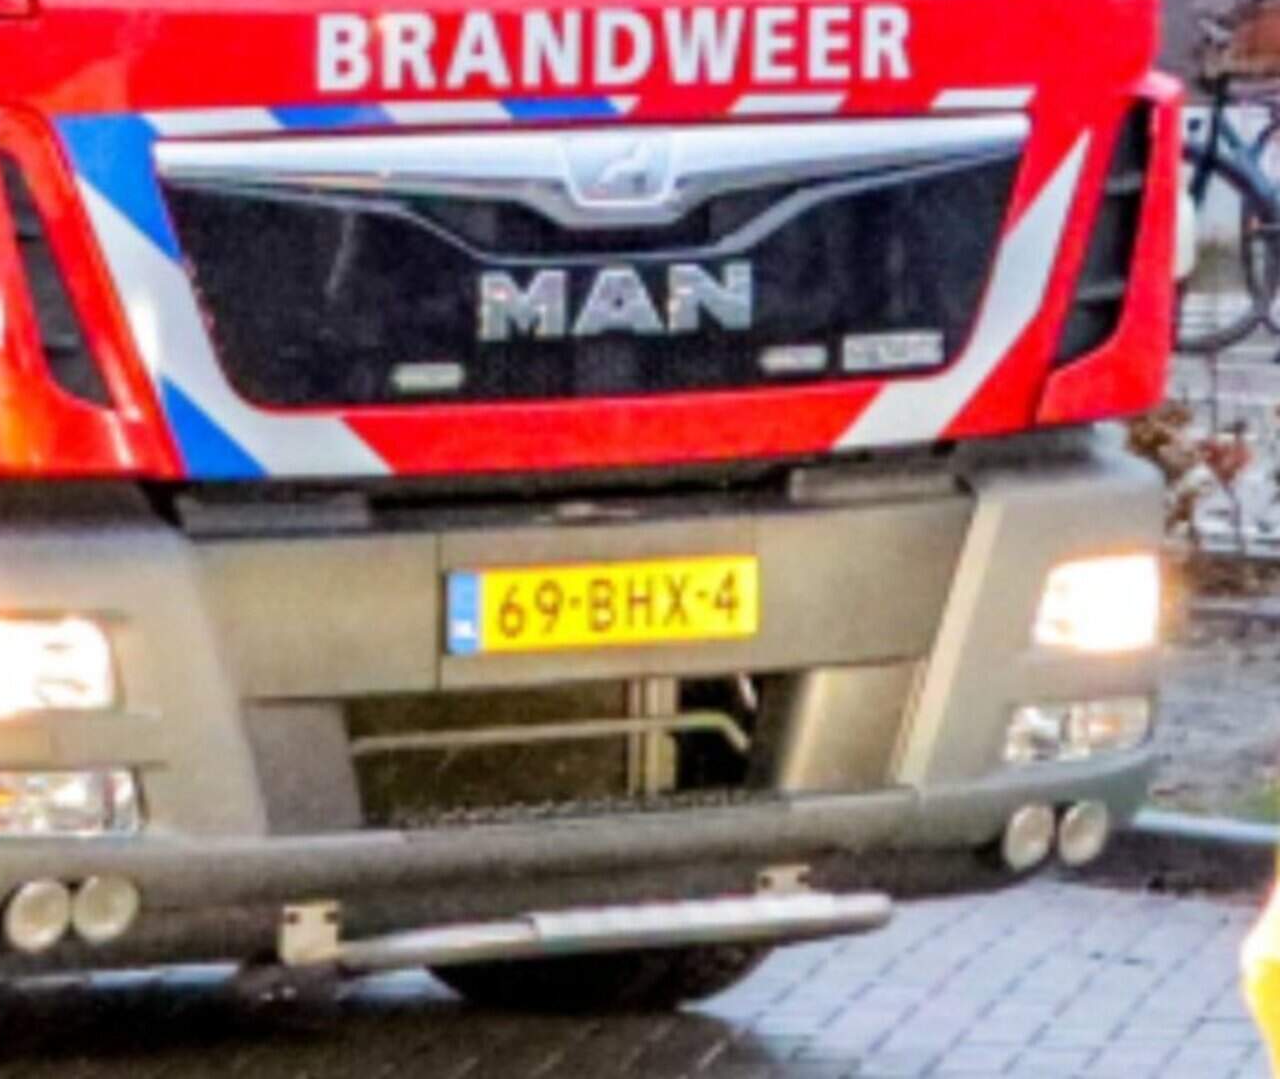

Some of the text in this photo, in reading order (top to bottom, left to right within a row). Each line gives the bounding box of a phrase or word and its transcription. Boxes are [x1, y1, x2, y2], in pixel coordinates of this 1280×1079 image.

[315, 3, 912, 92] BRANDWEER
[477, 261, 753, 342] MAN
[497, 572, 740, 639] 69-BHX-4
